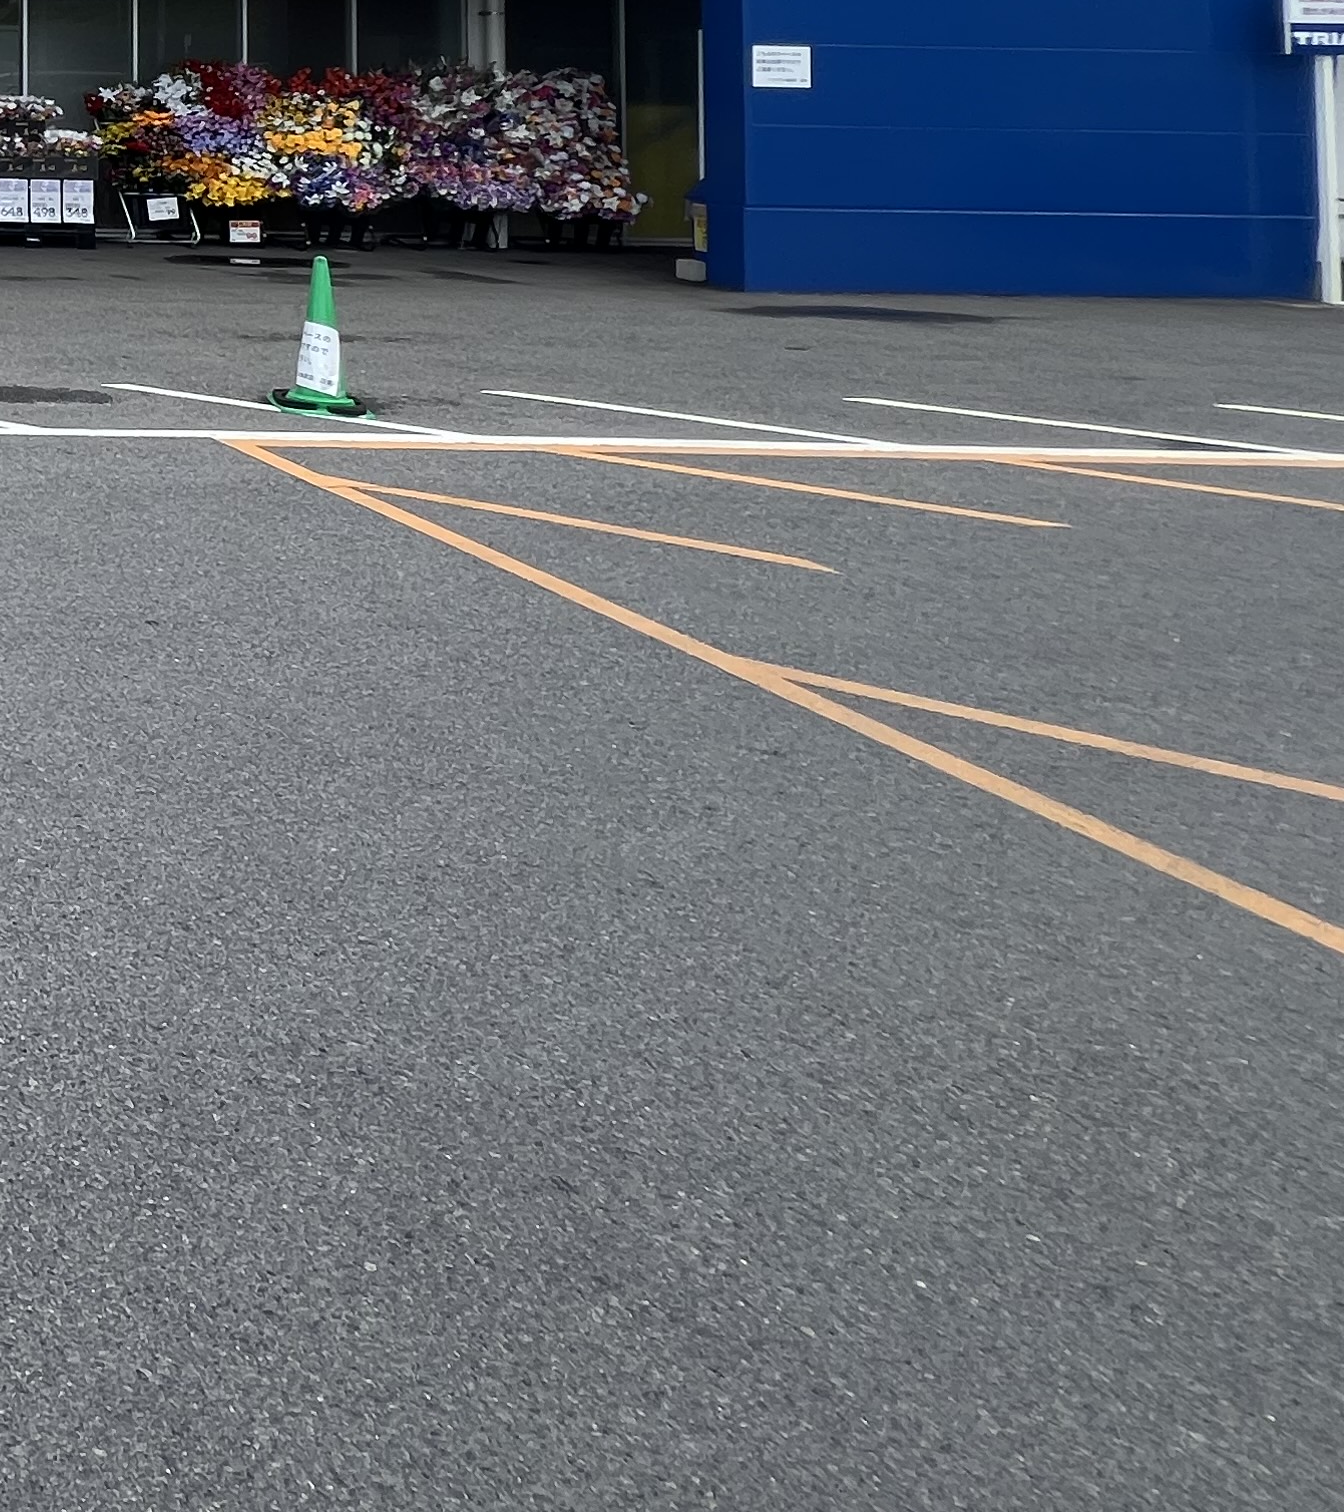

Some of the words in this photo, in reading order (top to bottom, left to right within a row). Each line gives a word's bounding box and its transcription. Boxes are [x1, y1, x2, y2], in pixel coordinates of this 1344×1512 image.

[1293, 31, 1344, 46] TRI
[0, 206, 24, 217] 648
[32, 207, 56, 217] 498
[65, 207, 88, 218] 348
